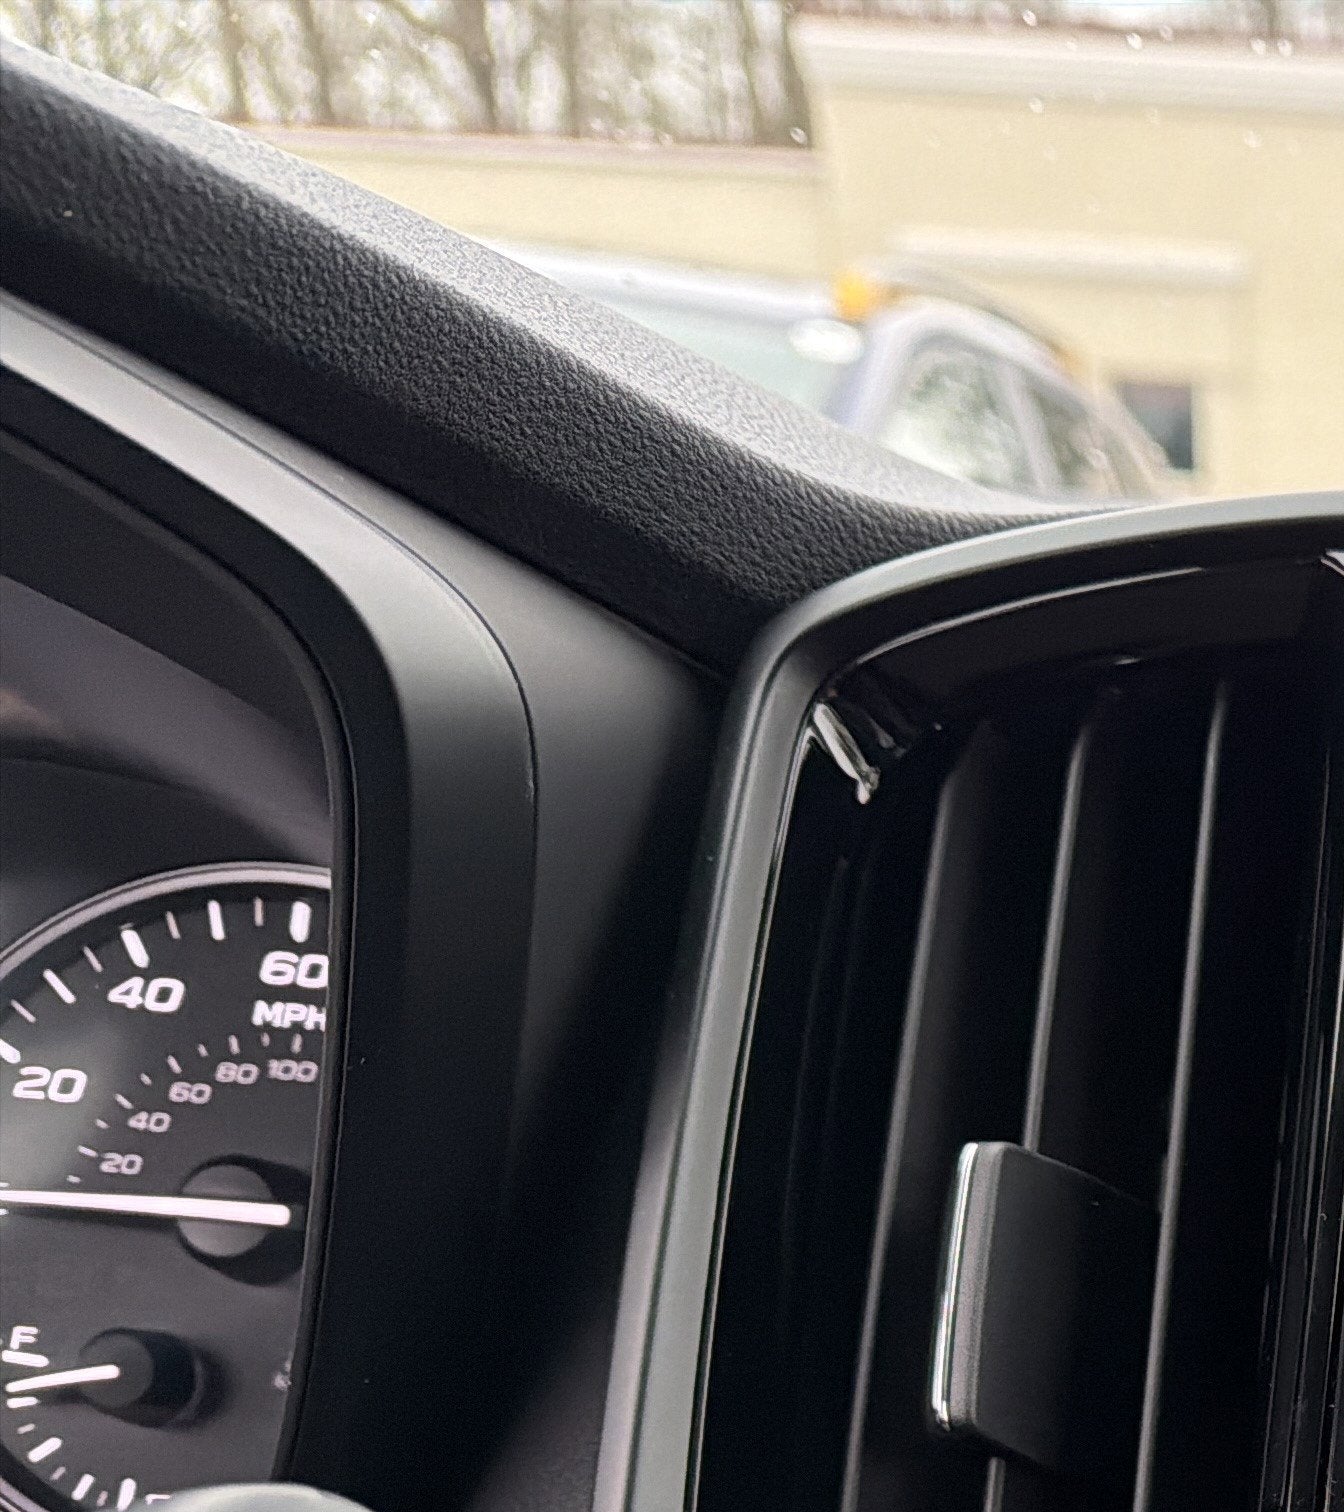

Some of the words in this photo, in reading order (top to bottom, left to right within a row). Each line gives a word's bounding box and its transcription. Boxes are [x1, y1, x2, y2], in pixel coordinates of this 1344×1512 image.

[260, 950, 328, 988] 60
[107, 976, 185, 1013] 40
[252, 1000, 327, 1032] MPH
[267, 1059, 318, 1083] 100
[12, 1066, 87, 1103] 20
[169, 1081, 212, 1105] 60
[128, 1111, 170, 1133] 40
[100, 1152, 143, 1175] 20
[10, 1325, 40, 1350] F
